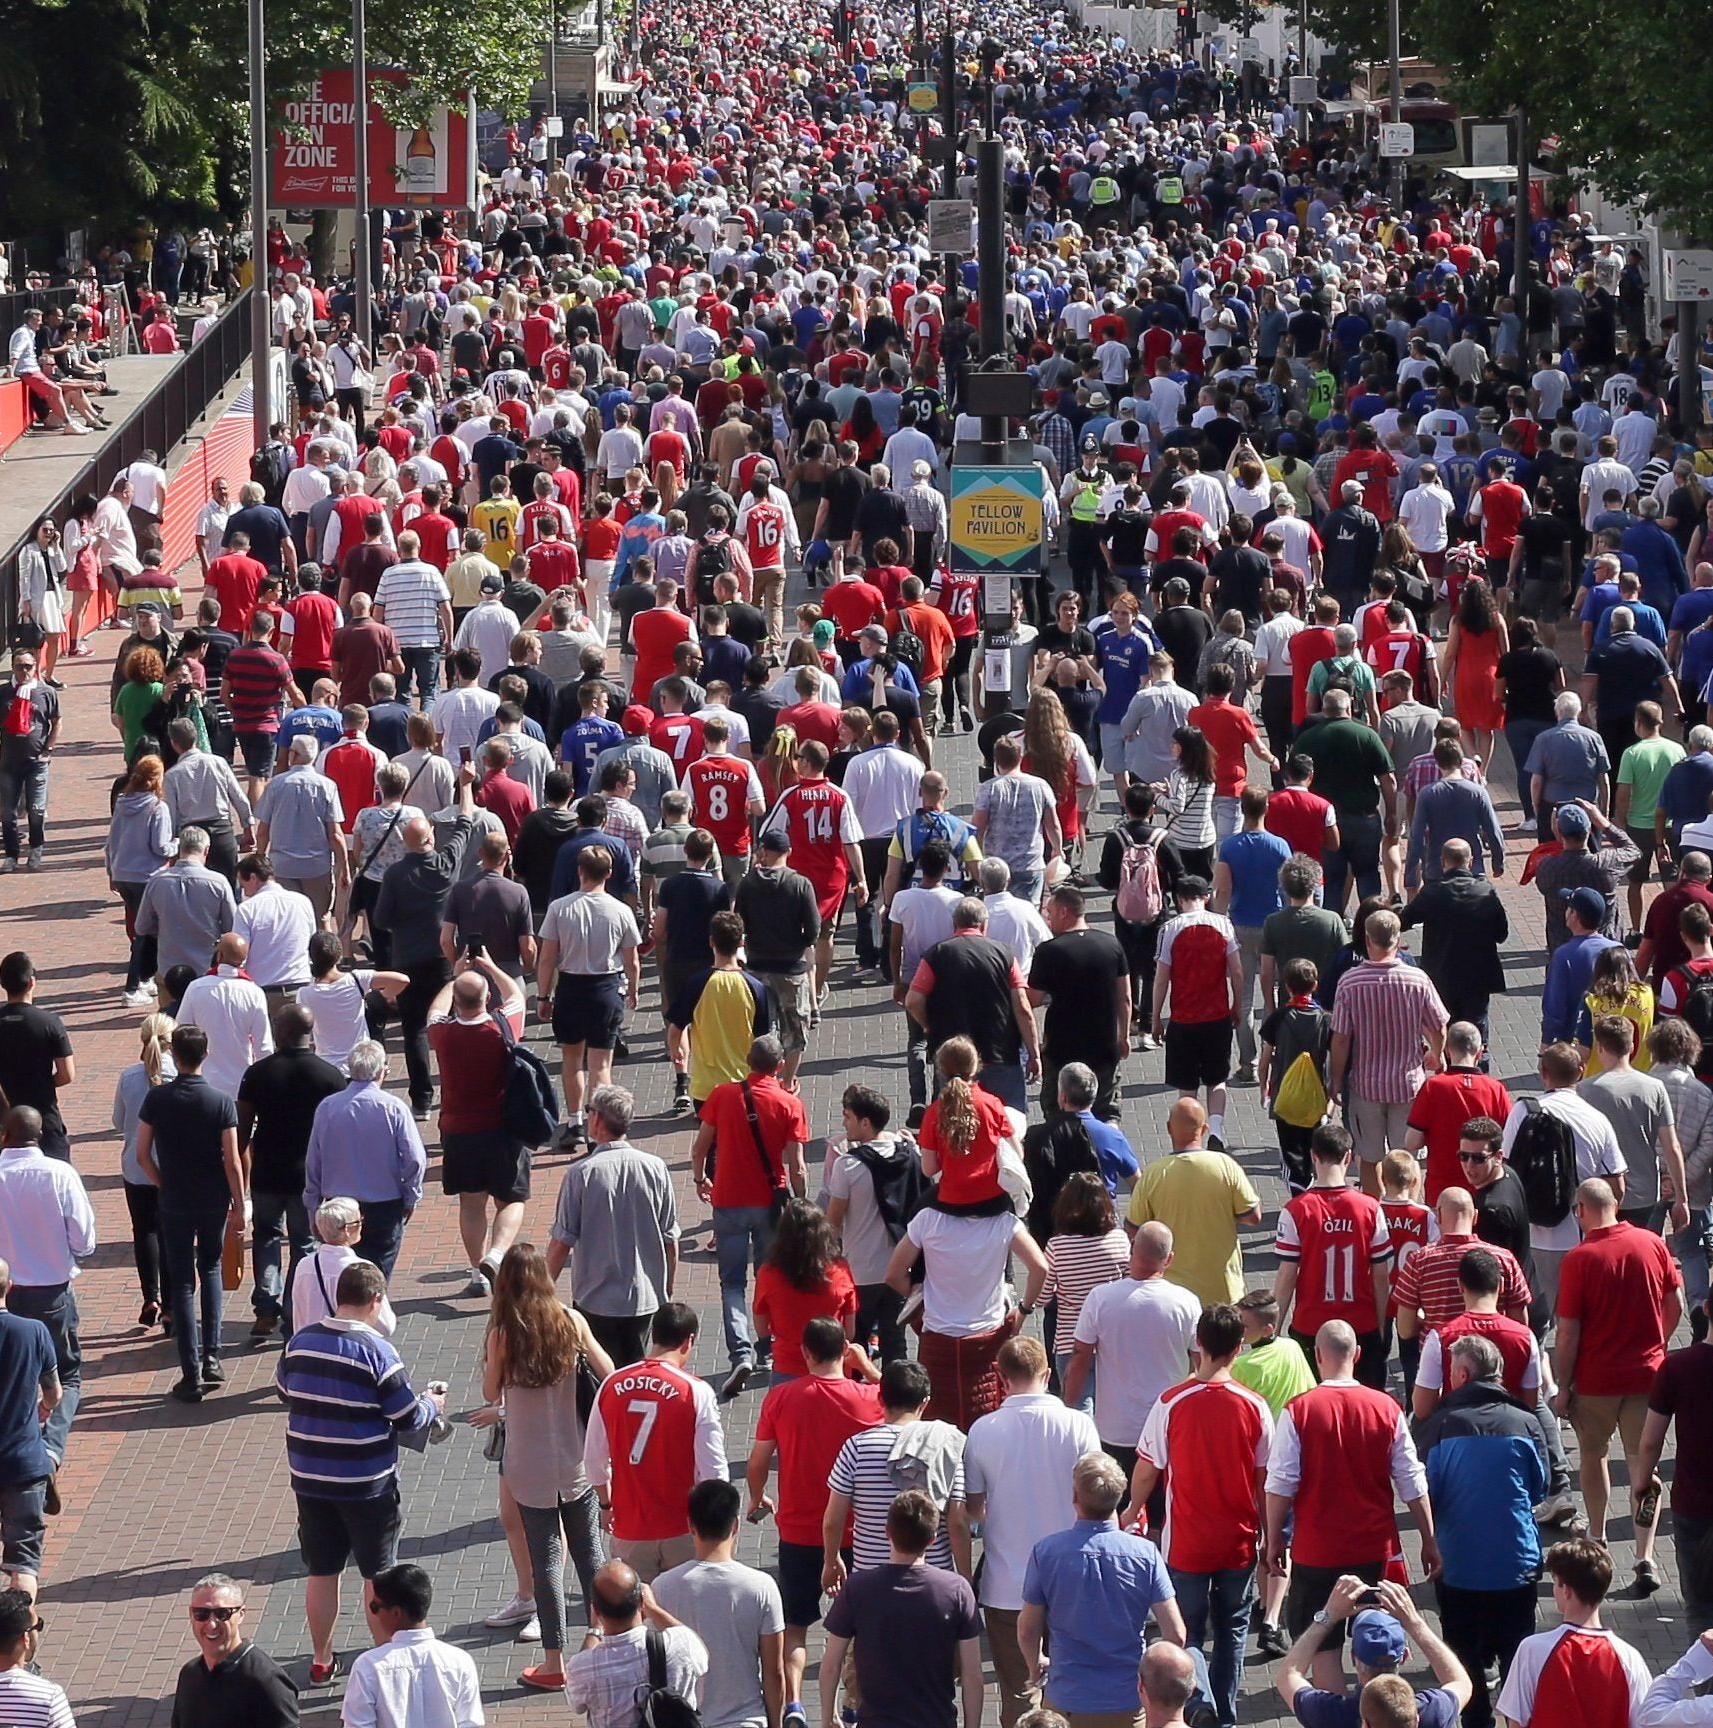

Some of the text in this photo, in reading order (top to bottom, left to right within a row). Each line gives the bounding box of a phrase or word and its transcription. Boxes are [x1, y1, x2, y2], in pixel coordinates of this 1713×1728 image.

[284, 146, 337, 168] ZONE
[552, 362, 560, 377] 6
[970, 504, 1023, 519] YELLOW
[488, 518, 508, 542] 16
[757, 519, 777, 548] 16
[966, 520, 1026, 536] PAVILION
[950, 587, 972, 616] 16
[1389, 641, 1411, 671] 7
[577, 726, 603, 737] ZOUMA
[667, 725, 692, 760] 7
[584, 742, 599, 765] 5
[700, 769, 739, 783] RAMSEY
[709, 784, 728, 821] 8
[800, 789, 831, 801] HENRY
[803, 806, 833, 844] 14
[1322, 1215, 1354, 1235] ÖZIL
[1322, 1244, 1354, 1303] 11
[613, 1375, 679, 1399] ROSICKY
[627, 1399, 658, 1465] 7
